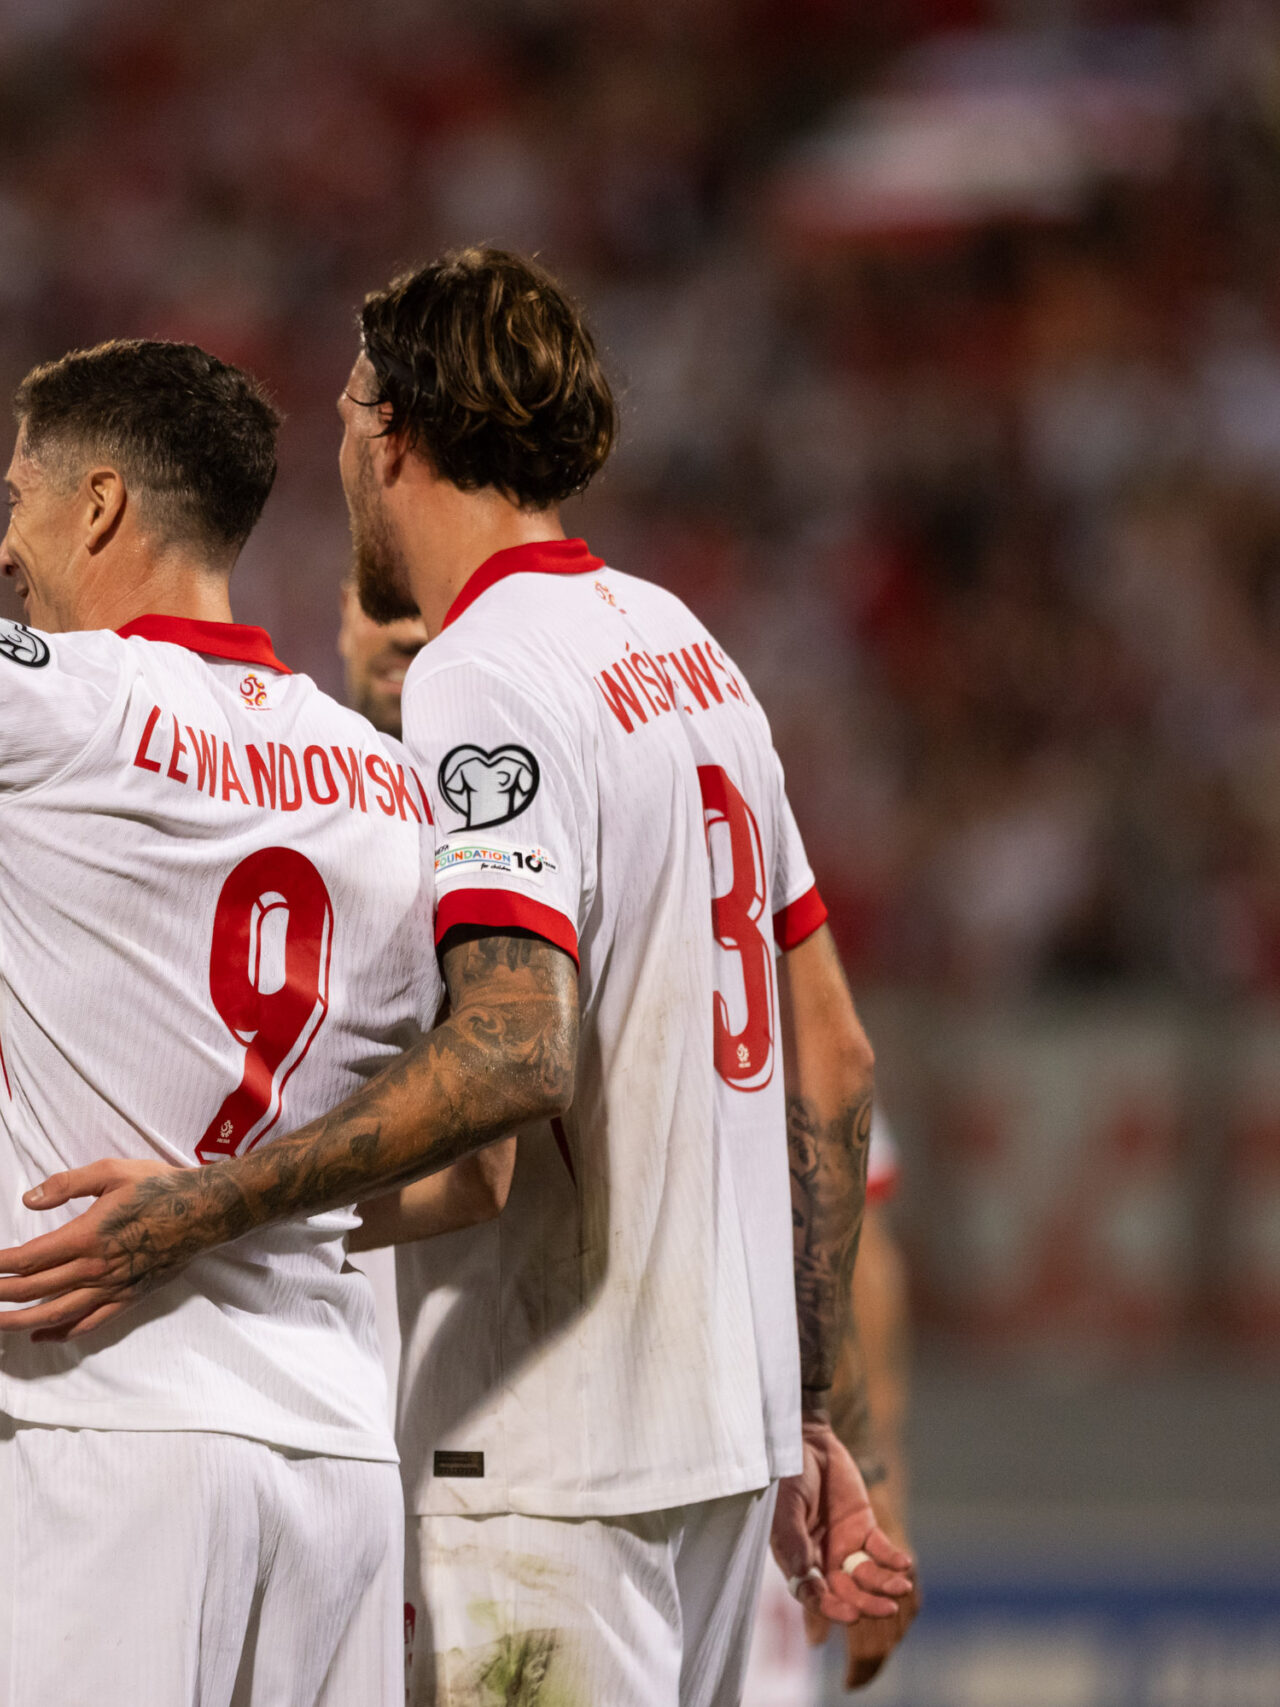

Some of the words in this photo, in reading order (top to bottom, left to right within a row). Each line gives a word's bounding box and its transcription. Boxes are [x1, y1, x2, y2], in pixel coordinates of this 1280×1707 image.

[133, 703, 435, 826] LEWANDOWSKI
[434, 849, 511, 871] FOUNDATION
[513, 851, 543, 873] 10
[194, 846, 334, 1166] 9
[697, 764, 776, 1093] 3
